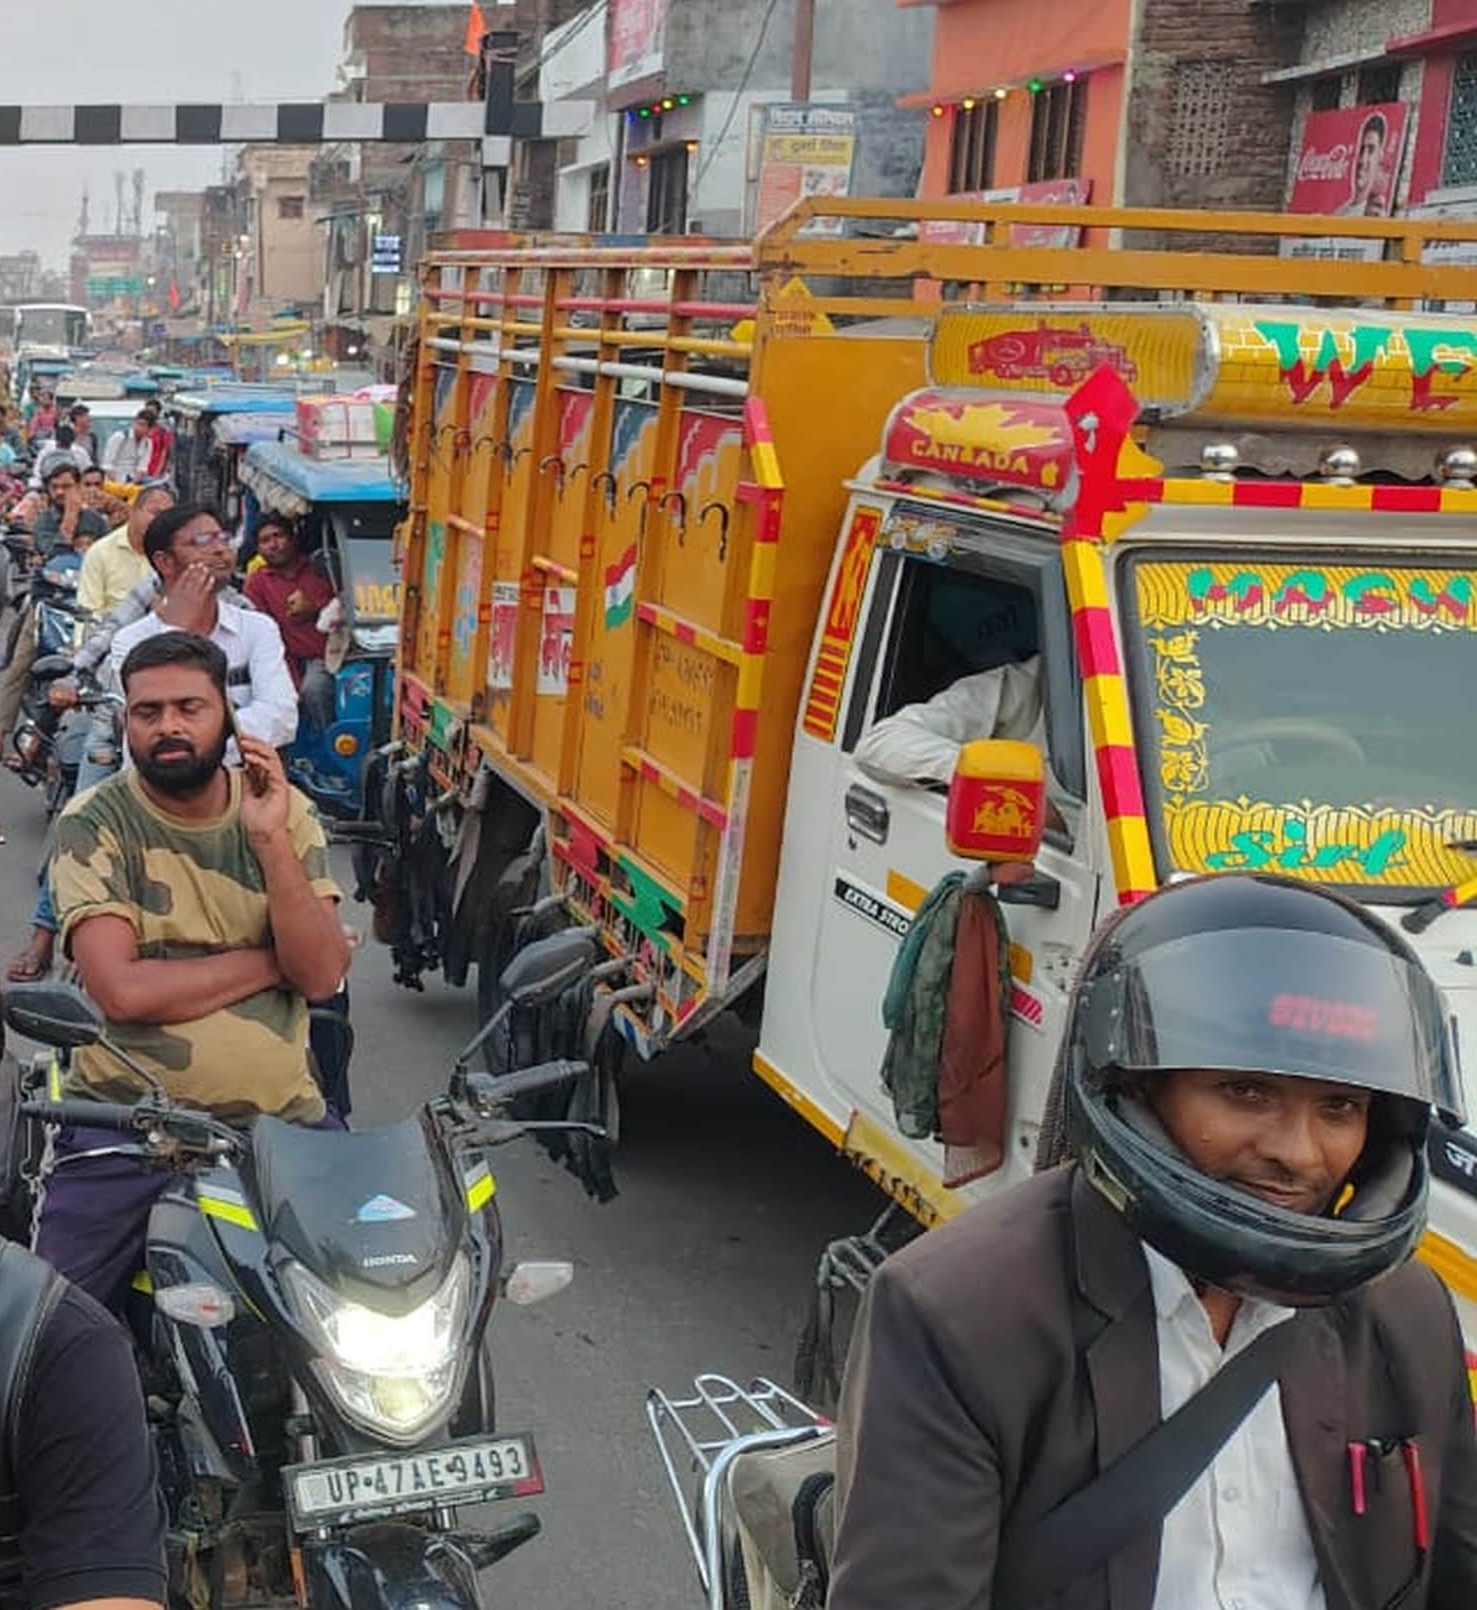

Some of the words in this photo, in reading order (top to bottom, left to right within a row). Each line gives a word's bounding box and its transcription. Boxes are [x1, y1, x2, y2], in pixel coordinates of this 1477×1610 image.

[843, 887, 879, 917] EXTRA
[880, 910, 909, 933] STRO
[363, 1253, 417, 1267] HONDA
